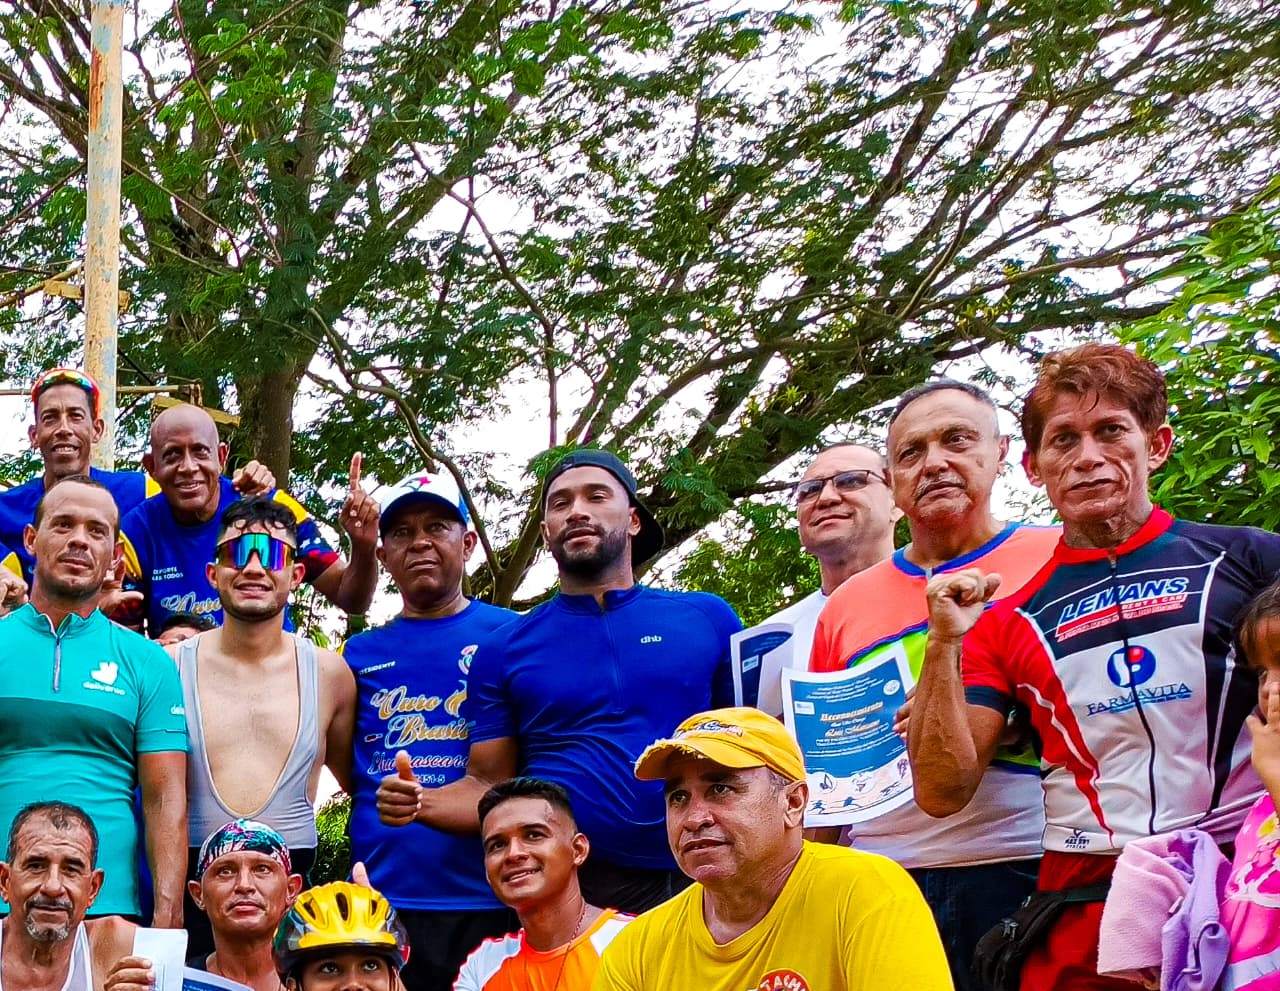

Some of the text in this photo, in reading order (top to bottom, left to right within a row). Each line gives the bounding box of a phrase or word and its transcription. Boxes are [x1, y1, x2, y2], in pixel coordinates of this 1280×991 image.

[1058, 578, 1188, 626] LEMANS
[1122, 600, 1148, 610] RENT
[641, 635, 662, 643] dhb
[1087, 682, 1193, 716] FARMAVITA
